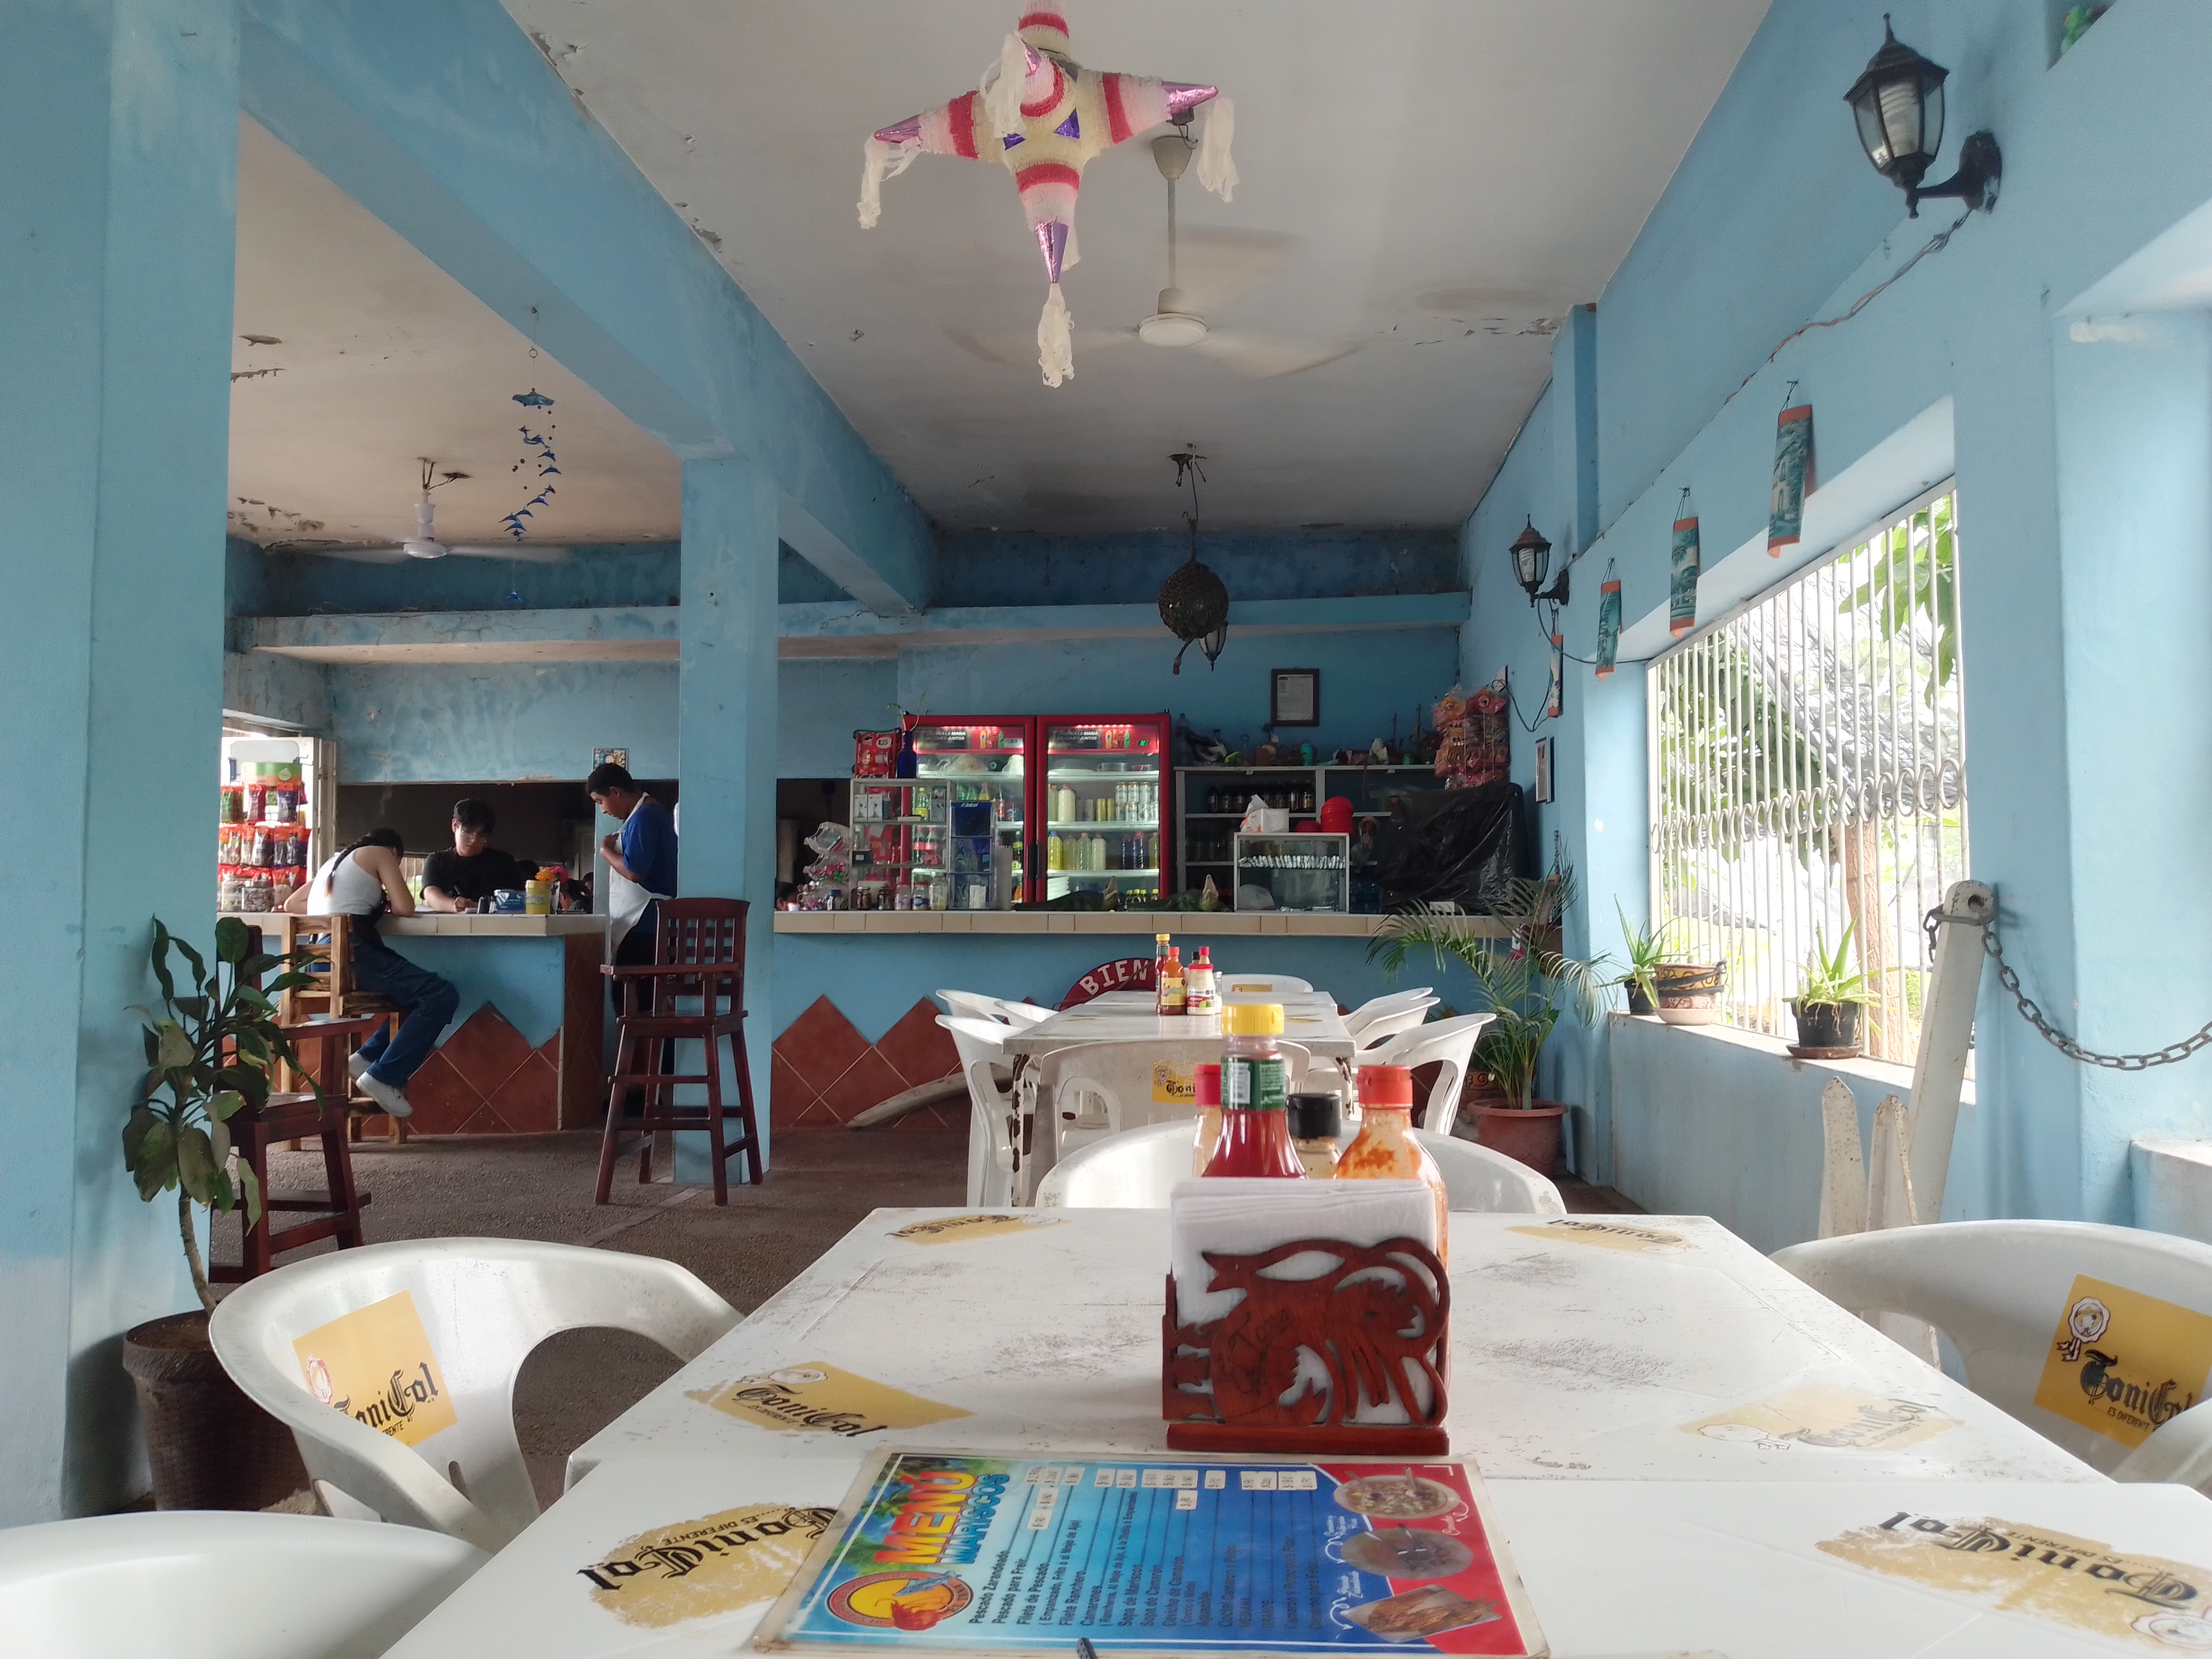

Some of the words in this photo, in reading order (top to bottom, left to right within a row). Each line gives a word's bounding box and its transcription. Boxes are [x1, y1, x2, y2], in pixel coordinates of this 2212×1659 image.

[731, 1383, 888, 1437] ToniCol
[1779, 1398, 1938, 1448] ToniCol
[872, 1470, 980, 1564] MENÚ
[939, 1473, 1010, 1564] MARISCOS
[662, 1518, 739, 1546] DIFERENTE
[1878, 1511, 2199, 1610] ToniCol
[967, 1592, 995, 1623] Pescado
[981, 1550, 1011, 1590] Zarandeado
[1027, 1563, 1049, 1592] Pescado
[990, 1593, 1017, 1623] Pescado
[1006, 1576, 1025, 1591] para
[1023, 1593, 1040, 1603] de
[1121, 1596, 1137, 1606] de
[1143, 1597, 1157, 1606] de
[1015, 1605, 1036, 1624] Filete
[1058, 1605, 1077, 1625] Filete
[1117, 1608, 1139, 1626] Sopa
